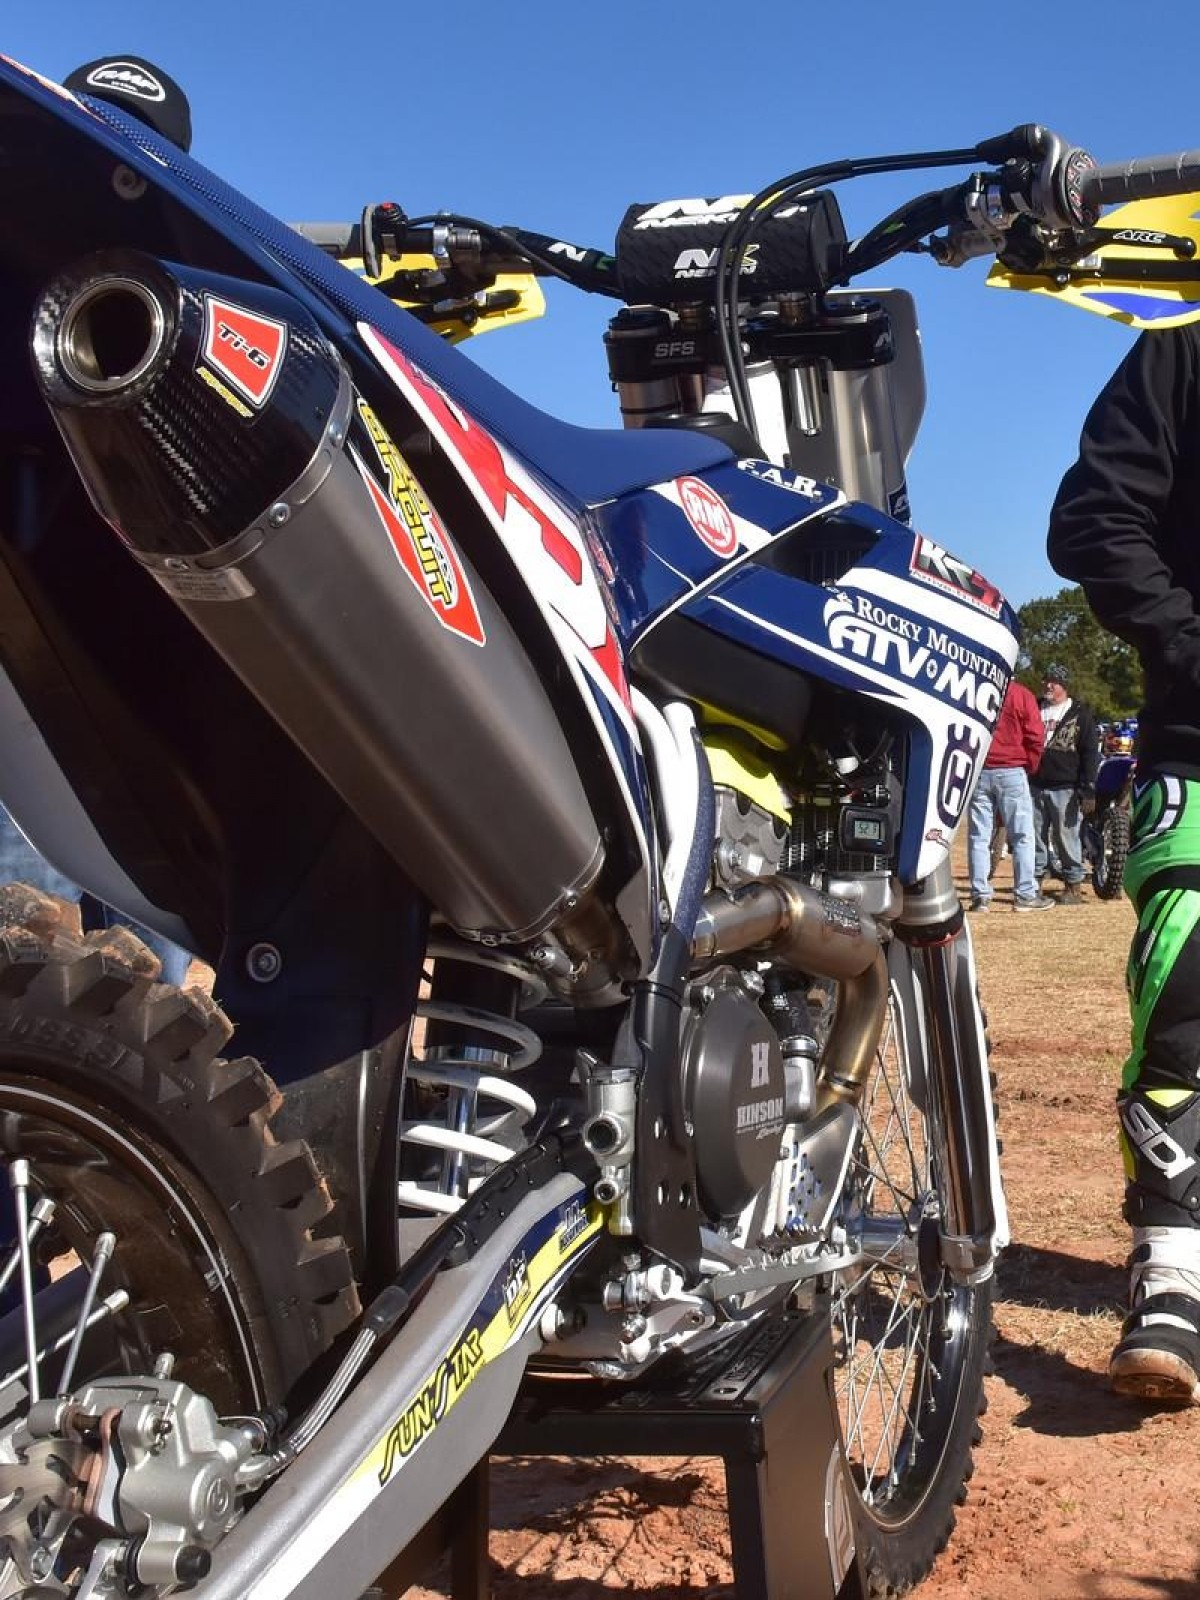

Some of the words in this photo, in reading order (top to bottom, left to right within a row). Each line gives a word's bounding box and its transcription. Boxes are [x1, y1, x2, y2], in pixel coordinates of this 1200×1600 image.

[1112, 229, 1167, 244] ARC
[654, 341, 696, 358] SFS
[358, 403, 452, 606] CIRCUIT
[856, 595, 922, 642] ROCKY
[737, 1097, 783, 1128] HINSON
